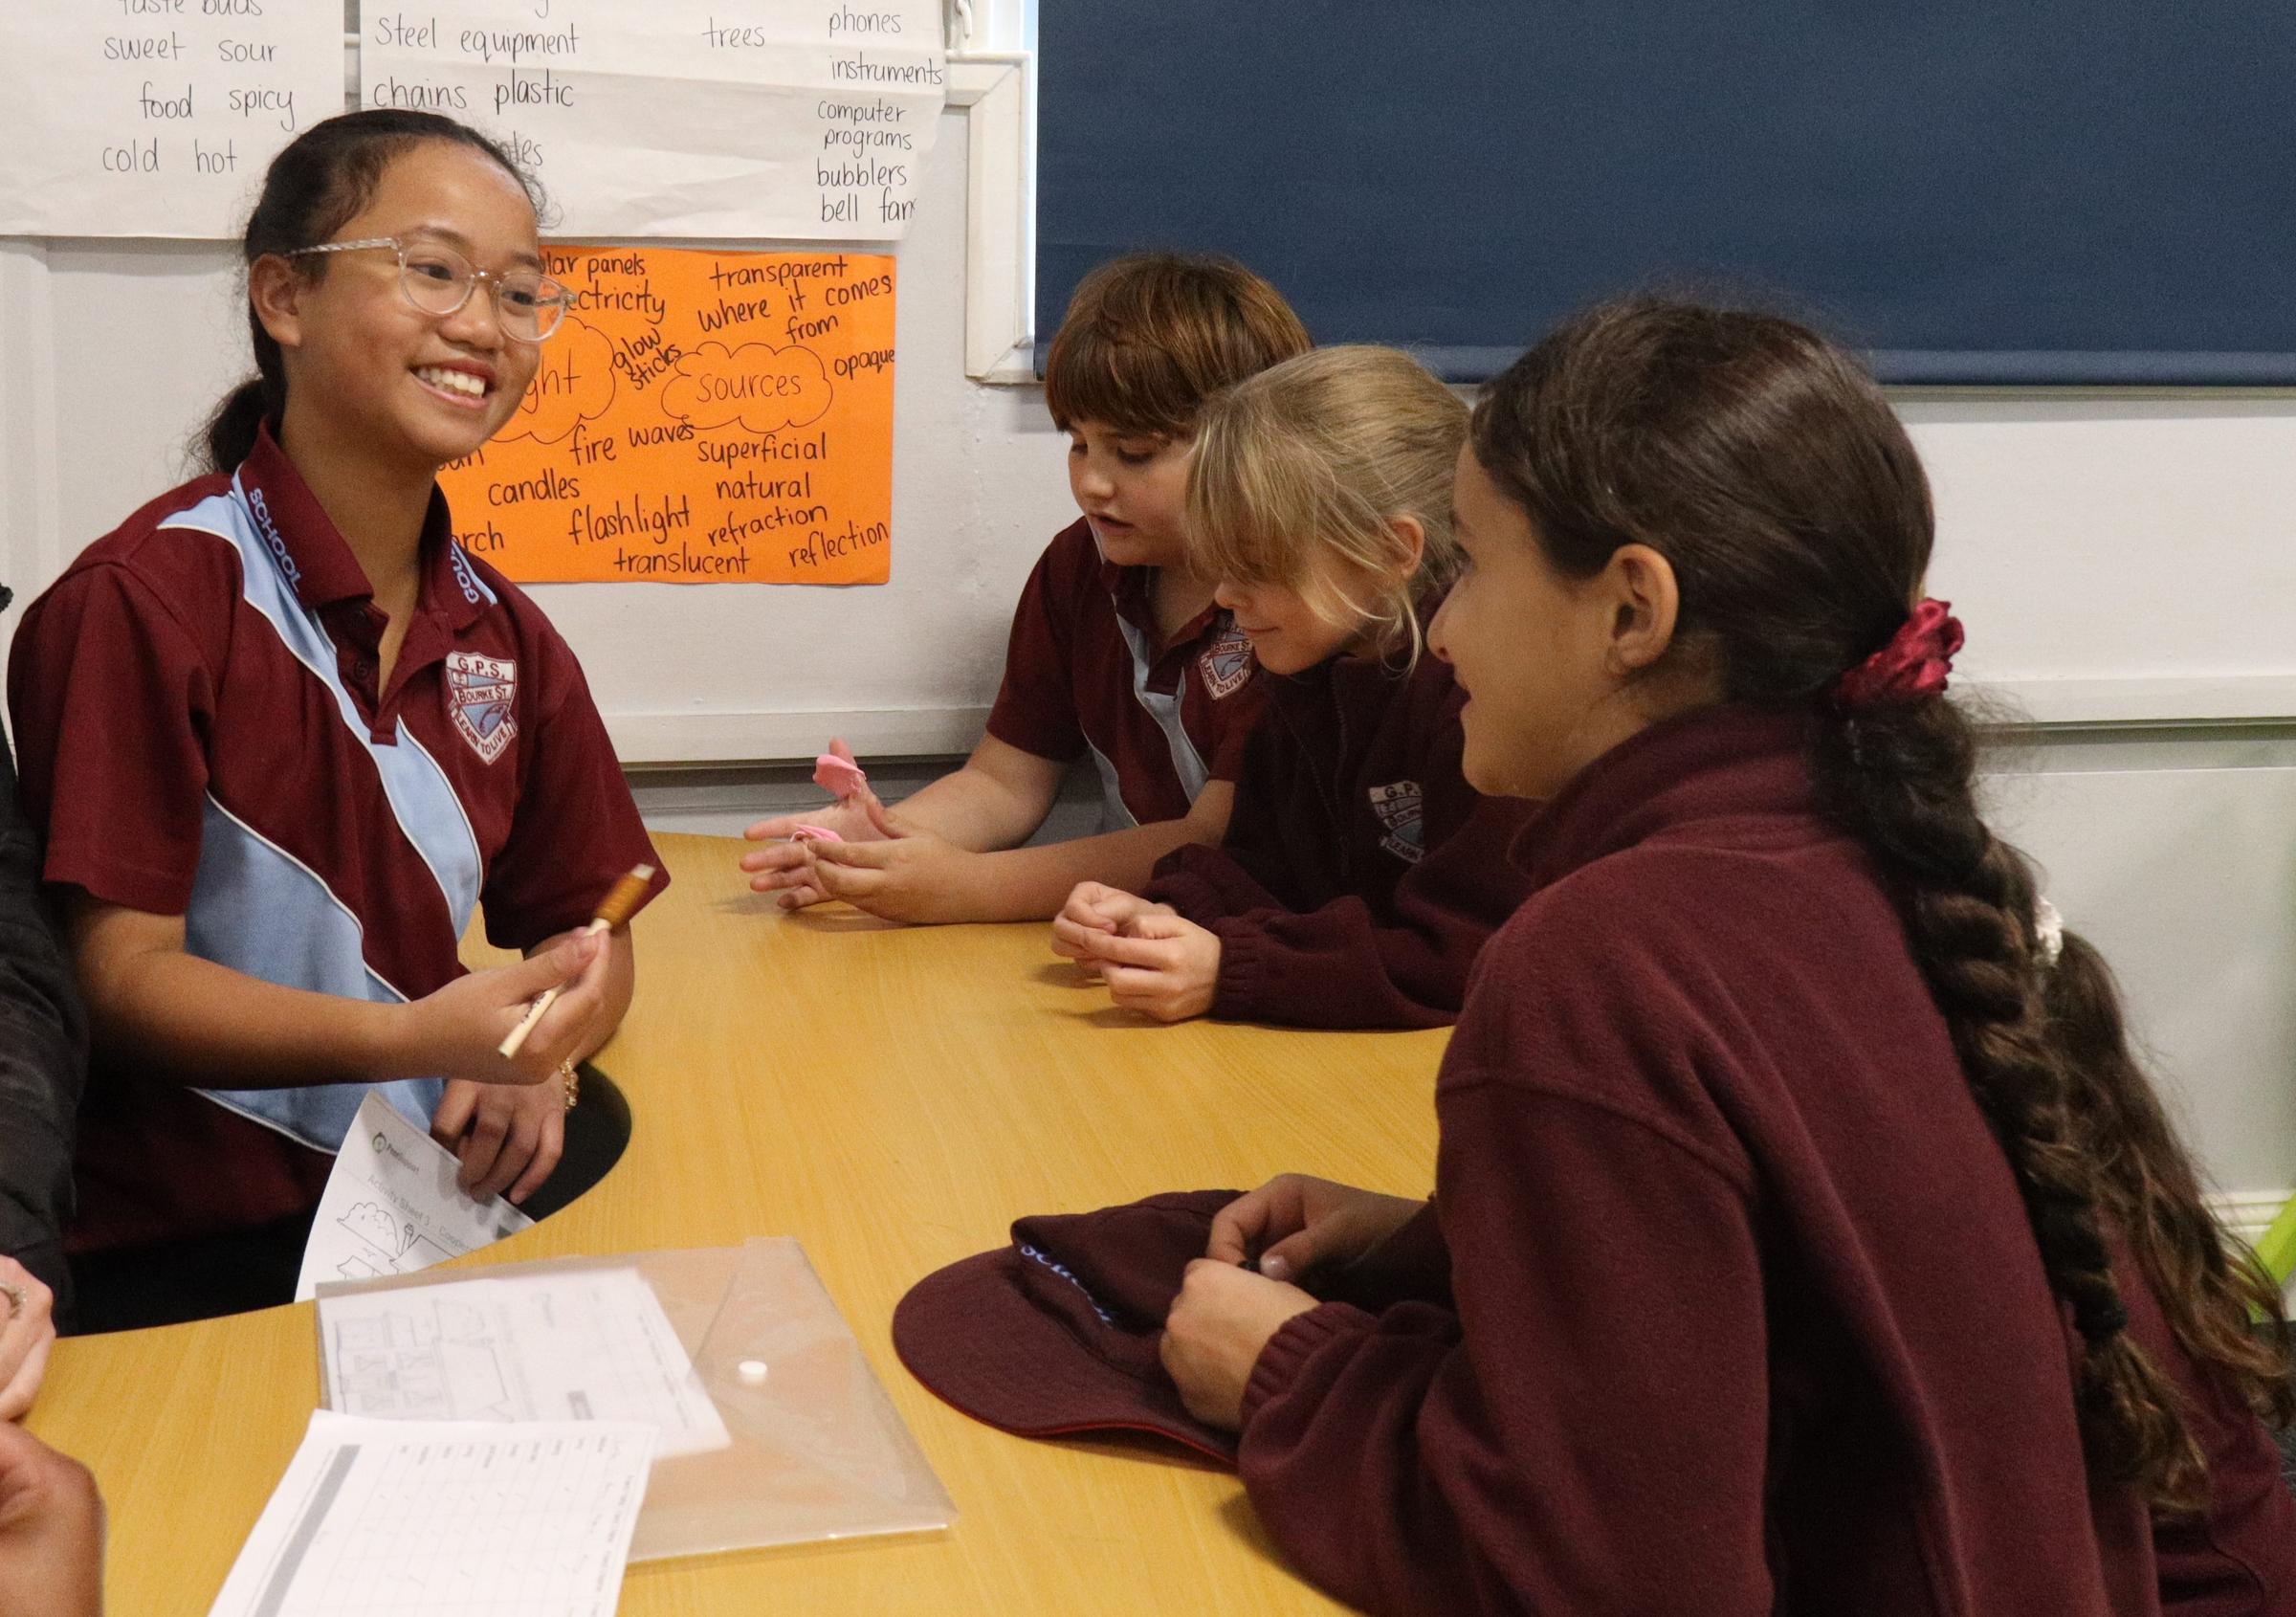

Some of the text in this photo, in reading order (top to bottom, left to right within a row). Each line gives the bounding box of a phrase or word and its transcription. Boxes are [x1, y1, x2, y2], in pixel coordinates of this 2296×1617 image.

[829, 4, 901, 38] phones
[104, 32, 277, 62] sweet sour
[461, 23, 581, 63] equipment
[701, 16, 765, 48] trees
[829, 51, 943, 85] instruments
[139, 81, 296, 132] food spicy
[374, 69, 575, 115] chains plastic
[818, 99, 908, 125] computer
[102, 138, 238, 173] cold hot
[825, 129, 913, 159] programs
[817, 157, 908, 187] bubblers
[821, 193, 858, 222] bell
[587, 253, 646, 282] panels
[709, 255, 850, 291] transparent
[698, 275, 893, 333] where it comes
[785, 314, 839, 343] from
[614, 327, 661, 375] glow
[630, 343, 682, 390] sticks
[834, 348, 895, 380] opaque
[569, 423, 695, 466] fire waves
[697, 432, 828, 469] superficial
[488, 467, 581, 506] candles
[716, 471, 811, 499] natural
[568, 494, 690, 545] flashlight
[708, 503, 828, 546] refraction
[250, 487, 301, 593] SCHOOL
[789, 520, 889, 568] reflection
[613, 542, 750, 575] translucent
[457, 656, 506, 680] G.P.S.
[459, 688, 495, 705] BOURKE
